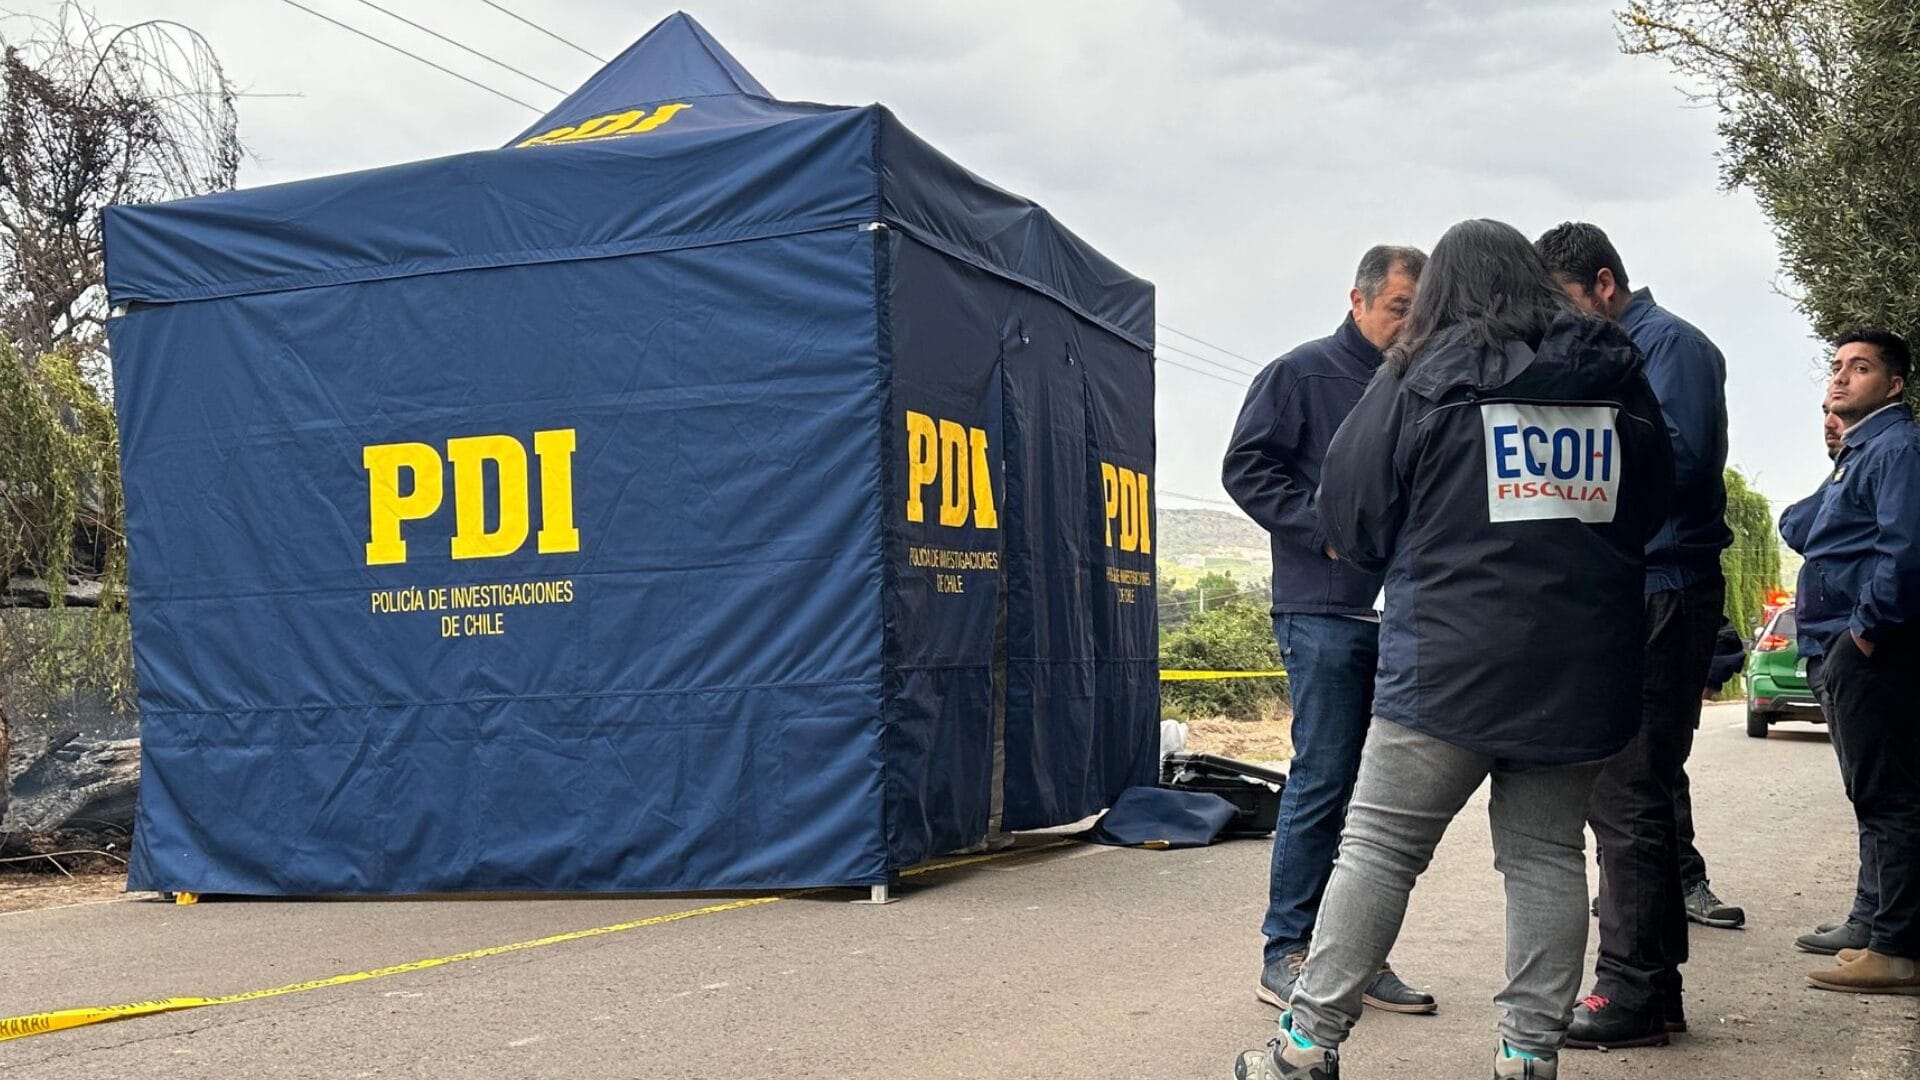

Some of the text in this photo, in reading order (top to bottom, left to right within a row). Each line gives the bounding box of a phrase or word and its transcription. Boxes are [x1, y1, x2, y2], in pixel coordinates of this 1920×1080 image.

[515, 103, 693, 148] PDI
[906, 410, 998, 529] PDI
[1493, 425, 1612, 481] ECOH
[363, 428, 580, 566] PDI
[1101, 462, 1151, 555] PDI
[1498, 482, 1608, 502] FISCALIA
[372, 580, 574, 613] POLICÍA DE INVESTIGACIONES
[441, 613, 504, 638] DE CHILE
